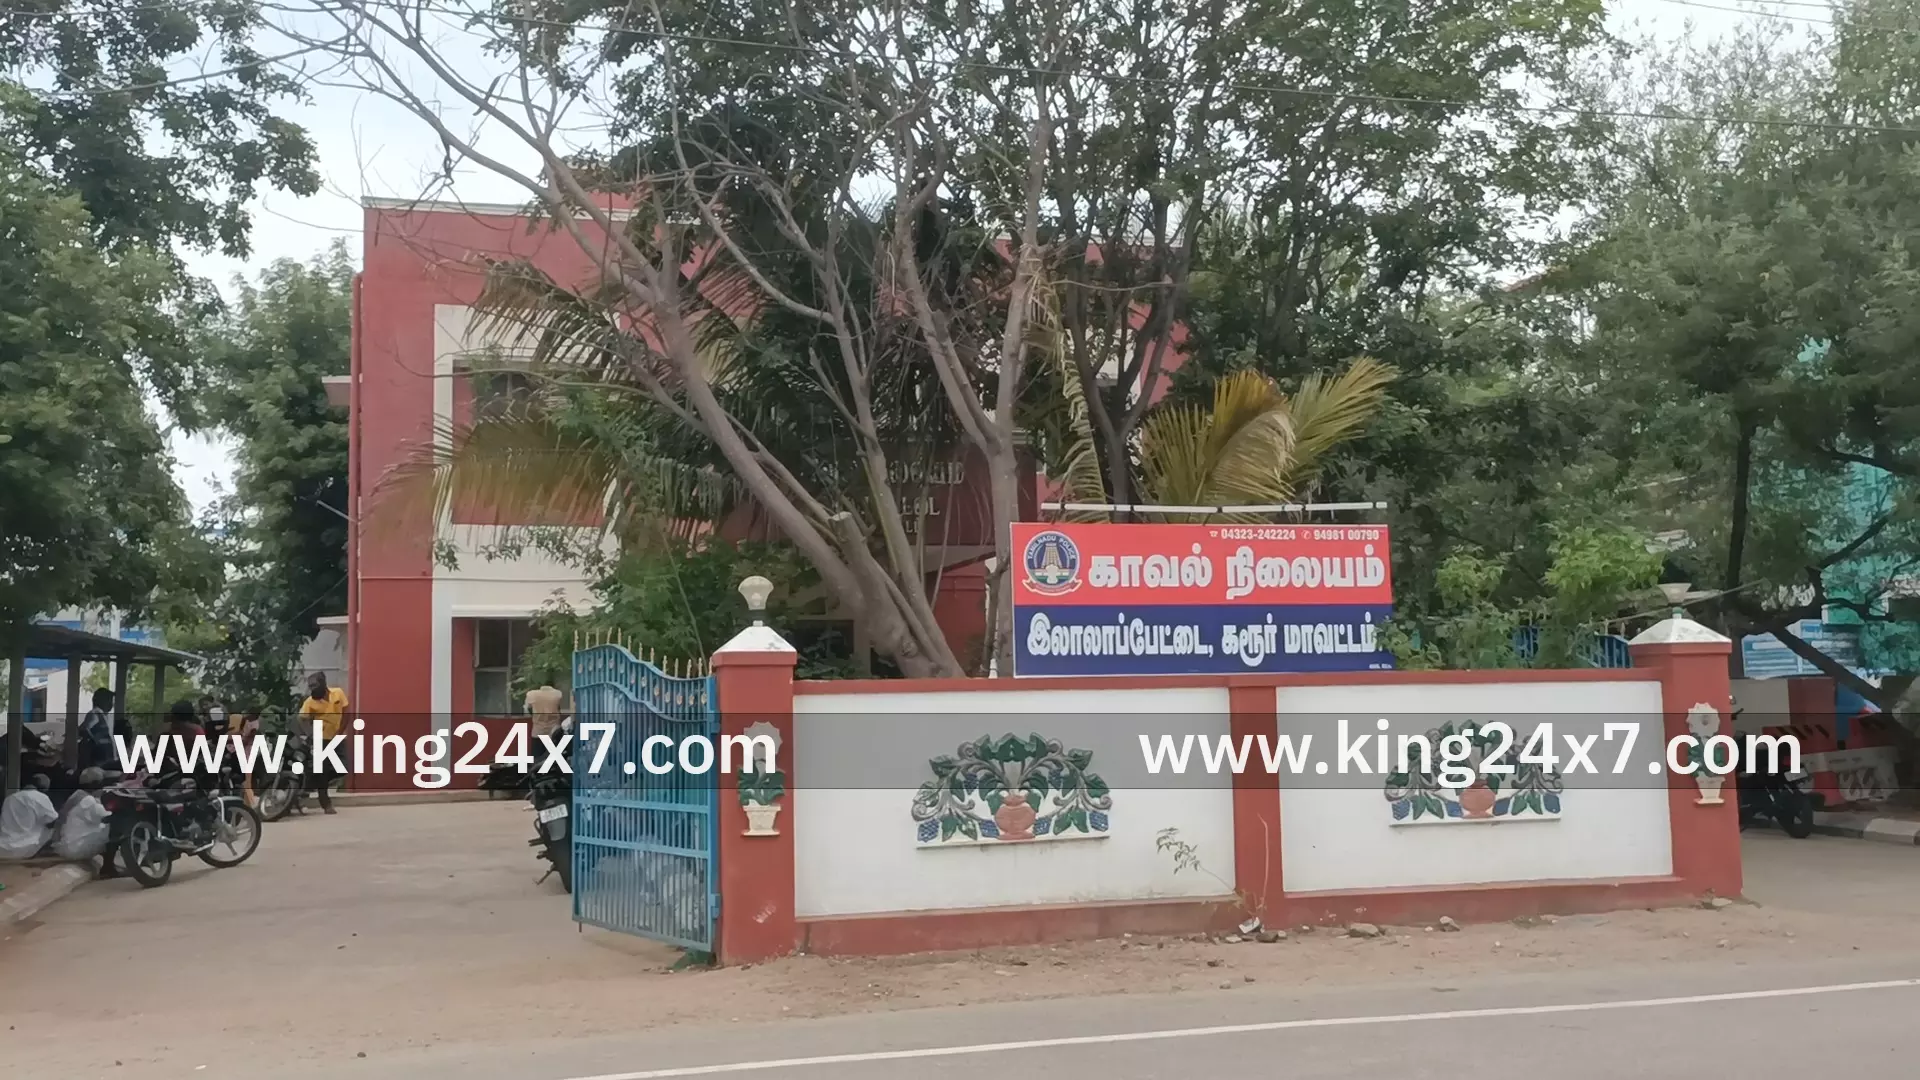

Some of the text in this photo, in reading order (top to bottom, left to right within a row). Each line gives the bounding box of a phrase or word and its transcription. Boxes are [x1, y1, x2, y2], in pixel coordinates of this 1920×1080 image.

[1221, 528, 1296, 540] 04323-242224
[1313, 529, 1379, 540] 94981 00790
[1058, 537, 1077, 560] POLICE
[1088, 543, 1385, 600] காவல் நிலையம்
[1027, 612, 1214, 658] இலாலாப்பேட்டை,
[1221, 612, 1278, 667] கரூர்
